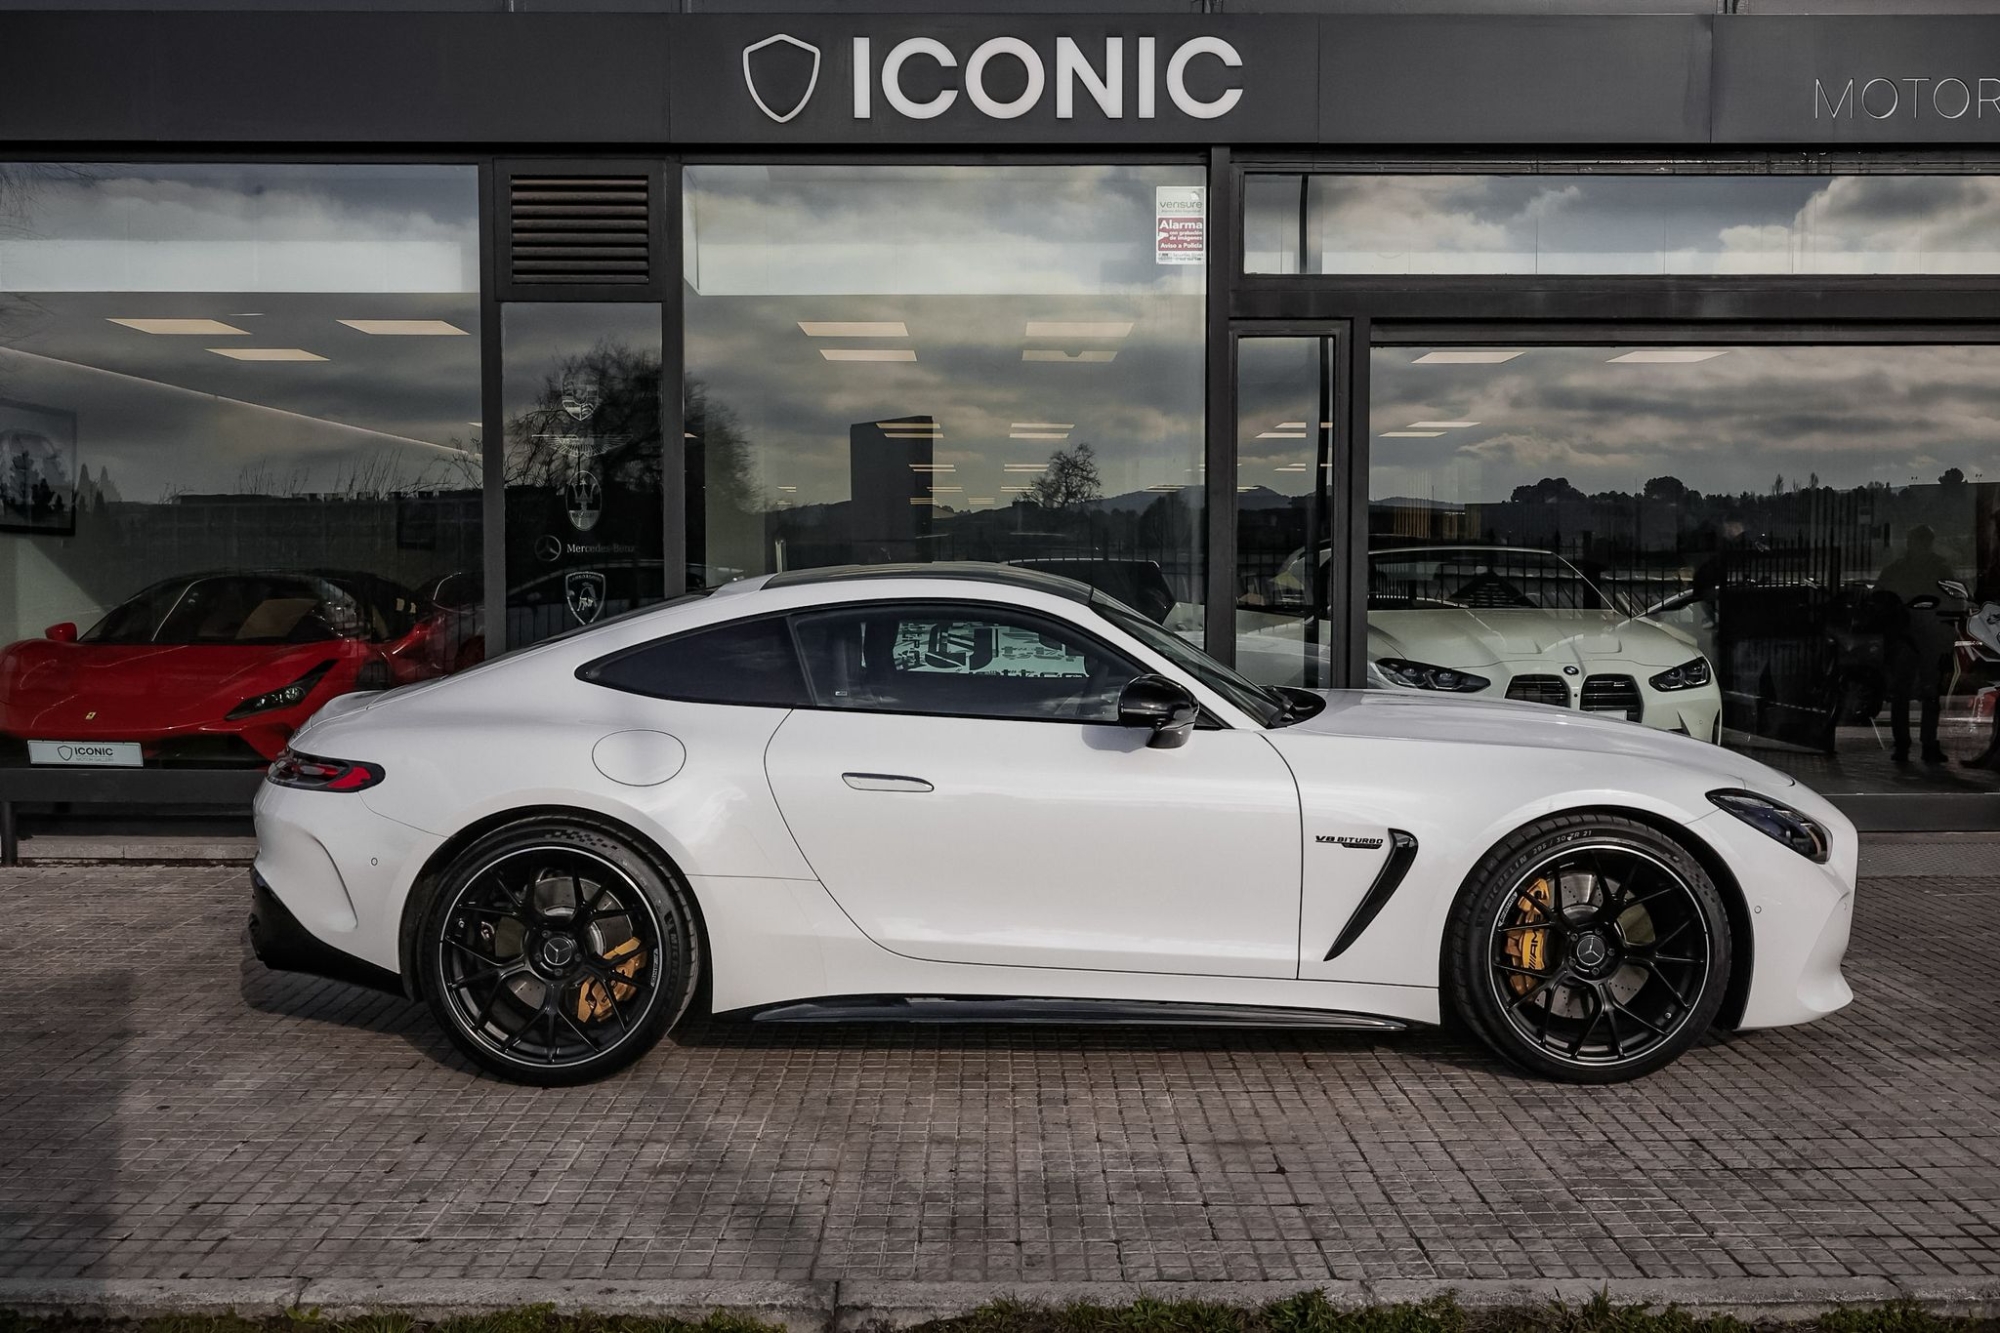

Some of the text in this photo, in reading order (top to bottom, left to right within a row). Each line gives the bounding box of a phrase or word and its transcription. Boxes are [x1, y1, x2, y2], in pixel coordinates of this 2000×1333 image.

[853, 36, 1243, 119] ICONIC
[1159, 219, 1203, 229] Alarma
[74, 747, 114, 756] ICONIC
[1337, 836, 1384, 844] BITURBO
